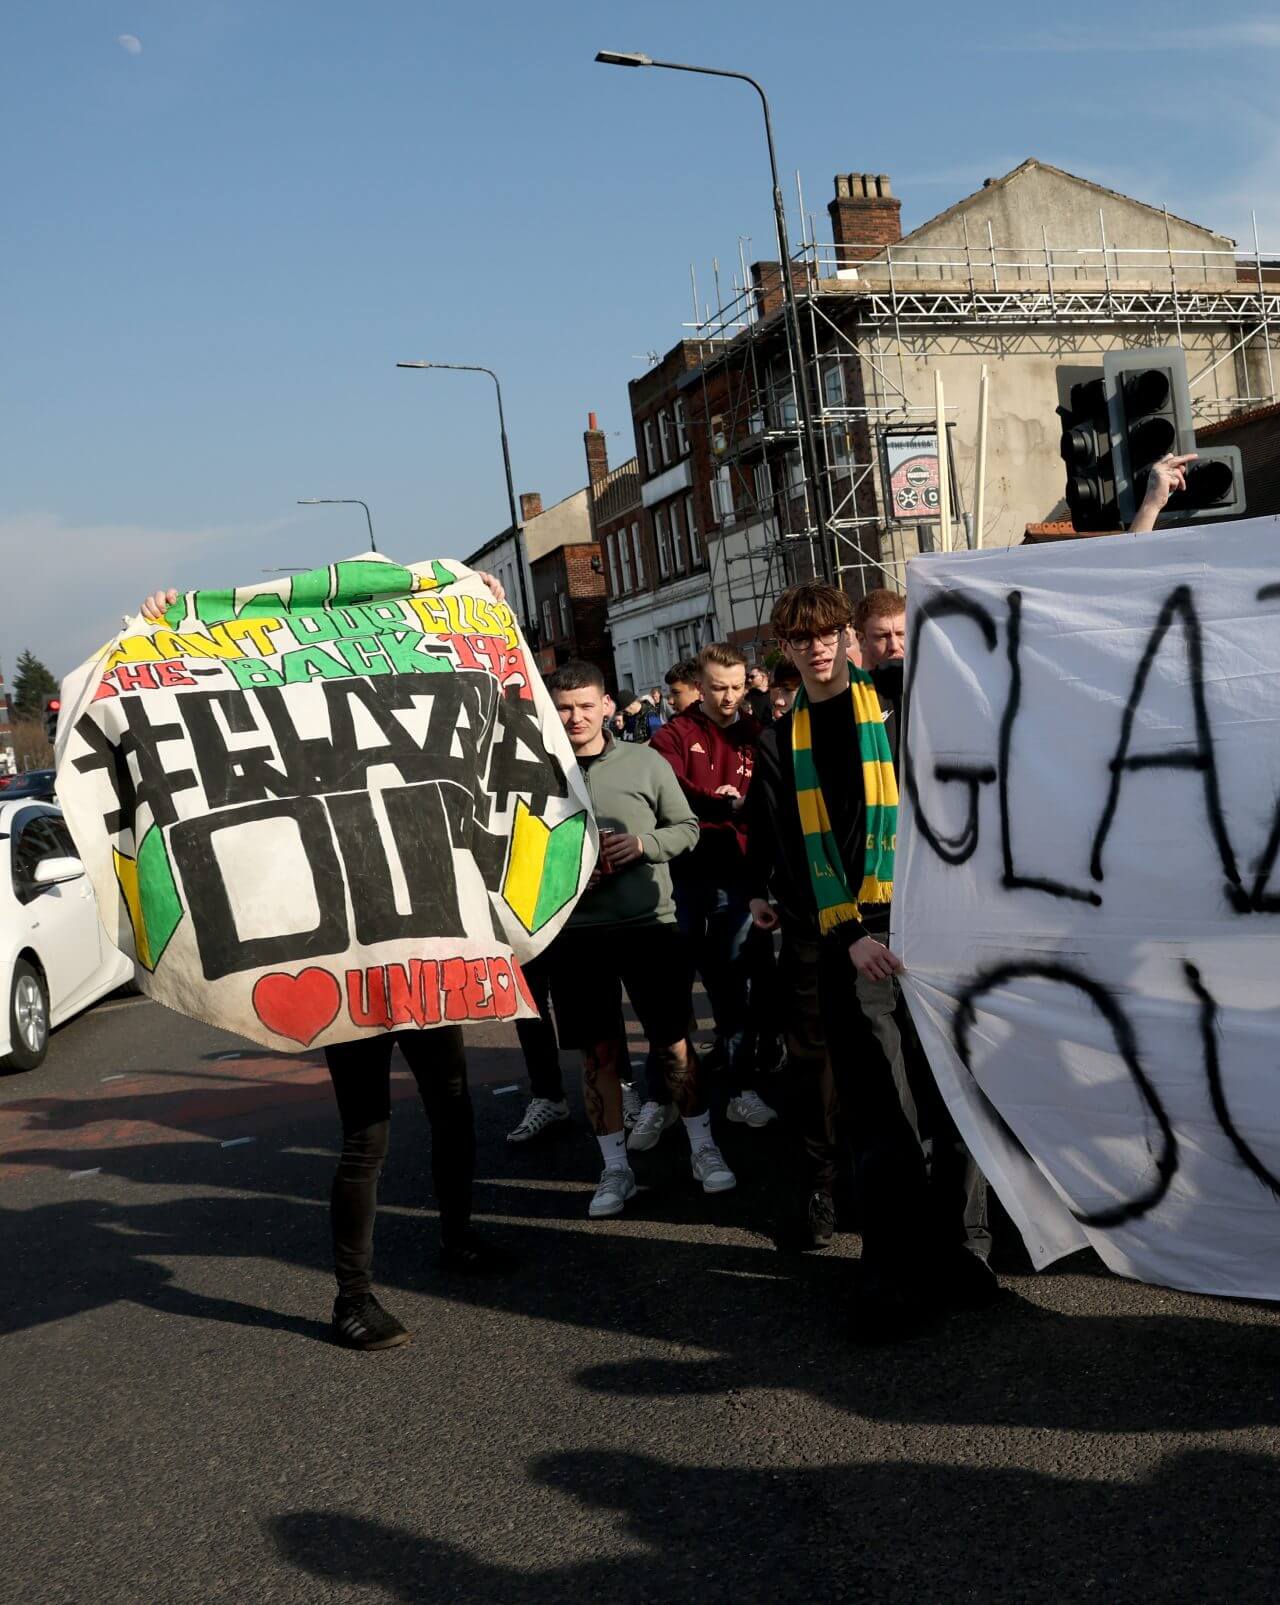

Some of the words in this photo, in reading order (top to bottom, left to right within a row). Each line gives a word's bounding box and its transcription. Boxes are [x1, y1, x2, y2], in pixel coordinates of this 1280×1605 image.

[283, 600, 416, 646] OUR
[408, 595, 519, 650] CLUB
[222, 630, 456, 690] BACK
[346, 956, 519, 1031] UNITED
